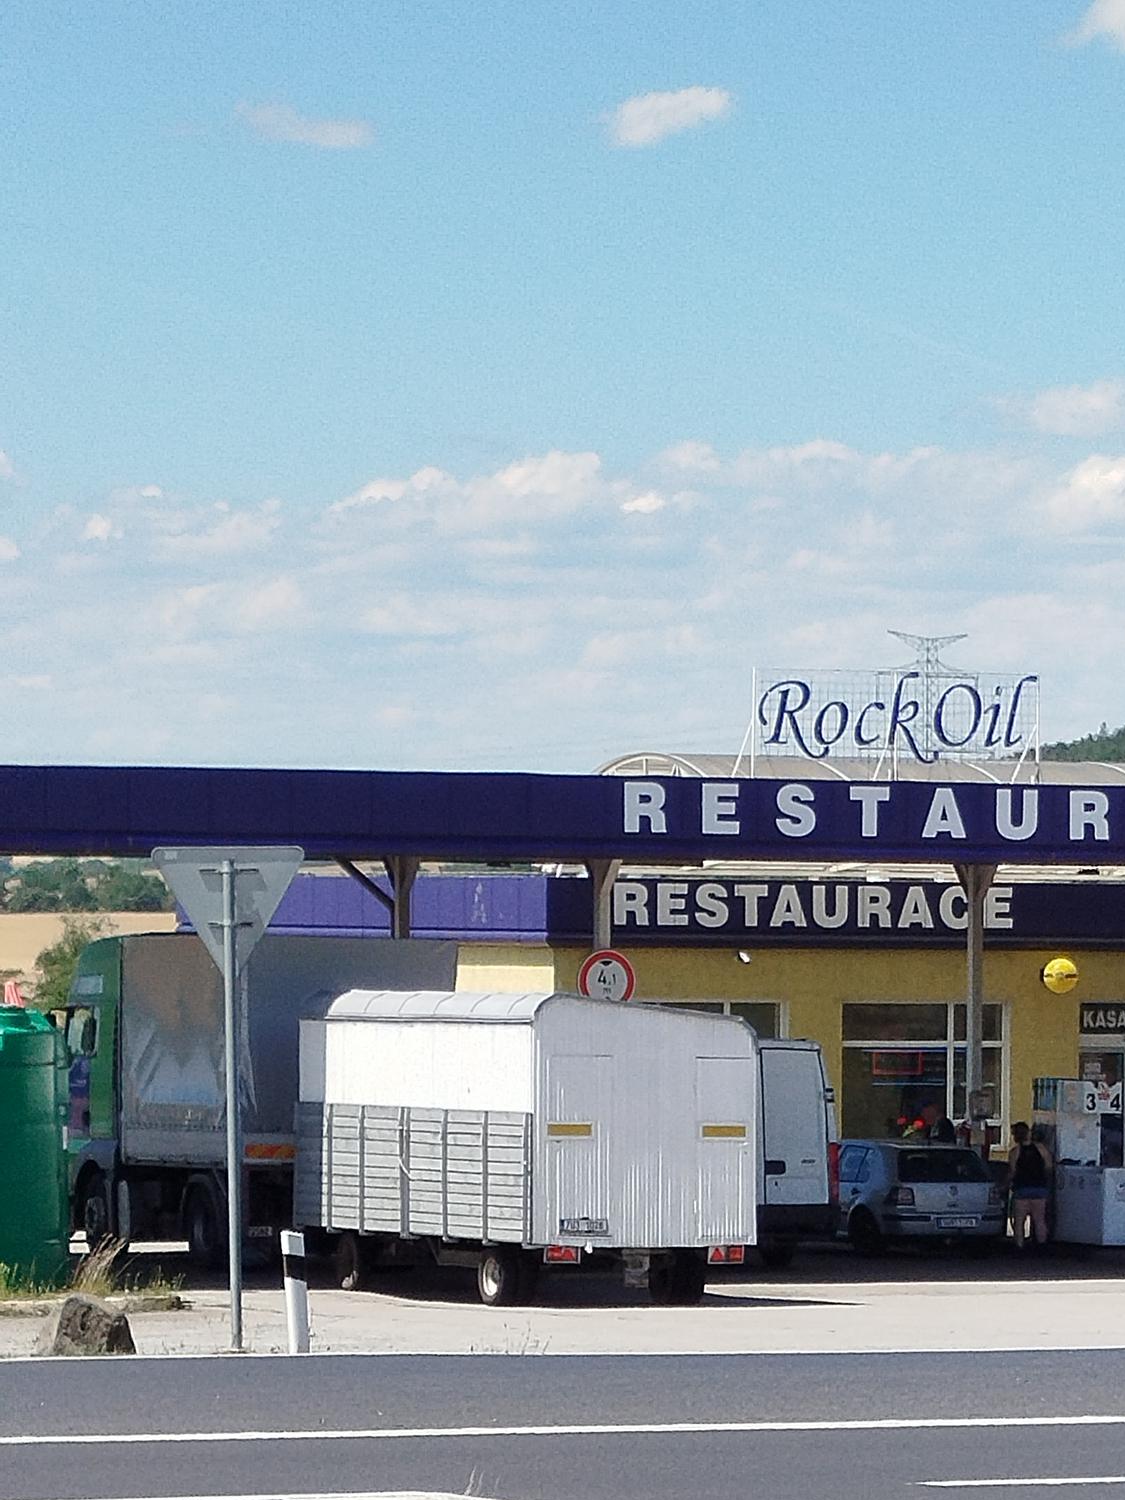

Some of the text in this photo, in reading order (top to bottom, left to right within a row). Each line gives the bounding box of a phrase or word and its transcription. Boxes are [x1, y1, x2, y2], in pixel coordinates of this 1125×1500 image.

[613, 882, 1014, 930] RESTAURACE
[1085, 1093, 1097, 1111] 3
[1110, 1093, 1121, 1111] 4
